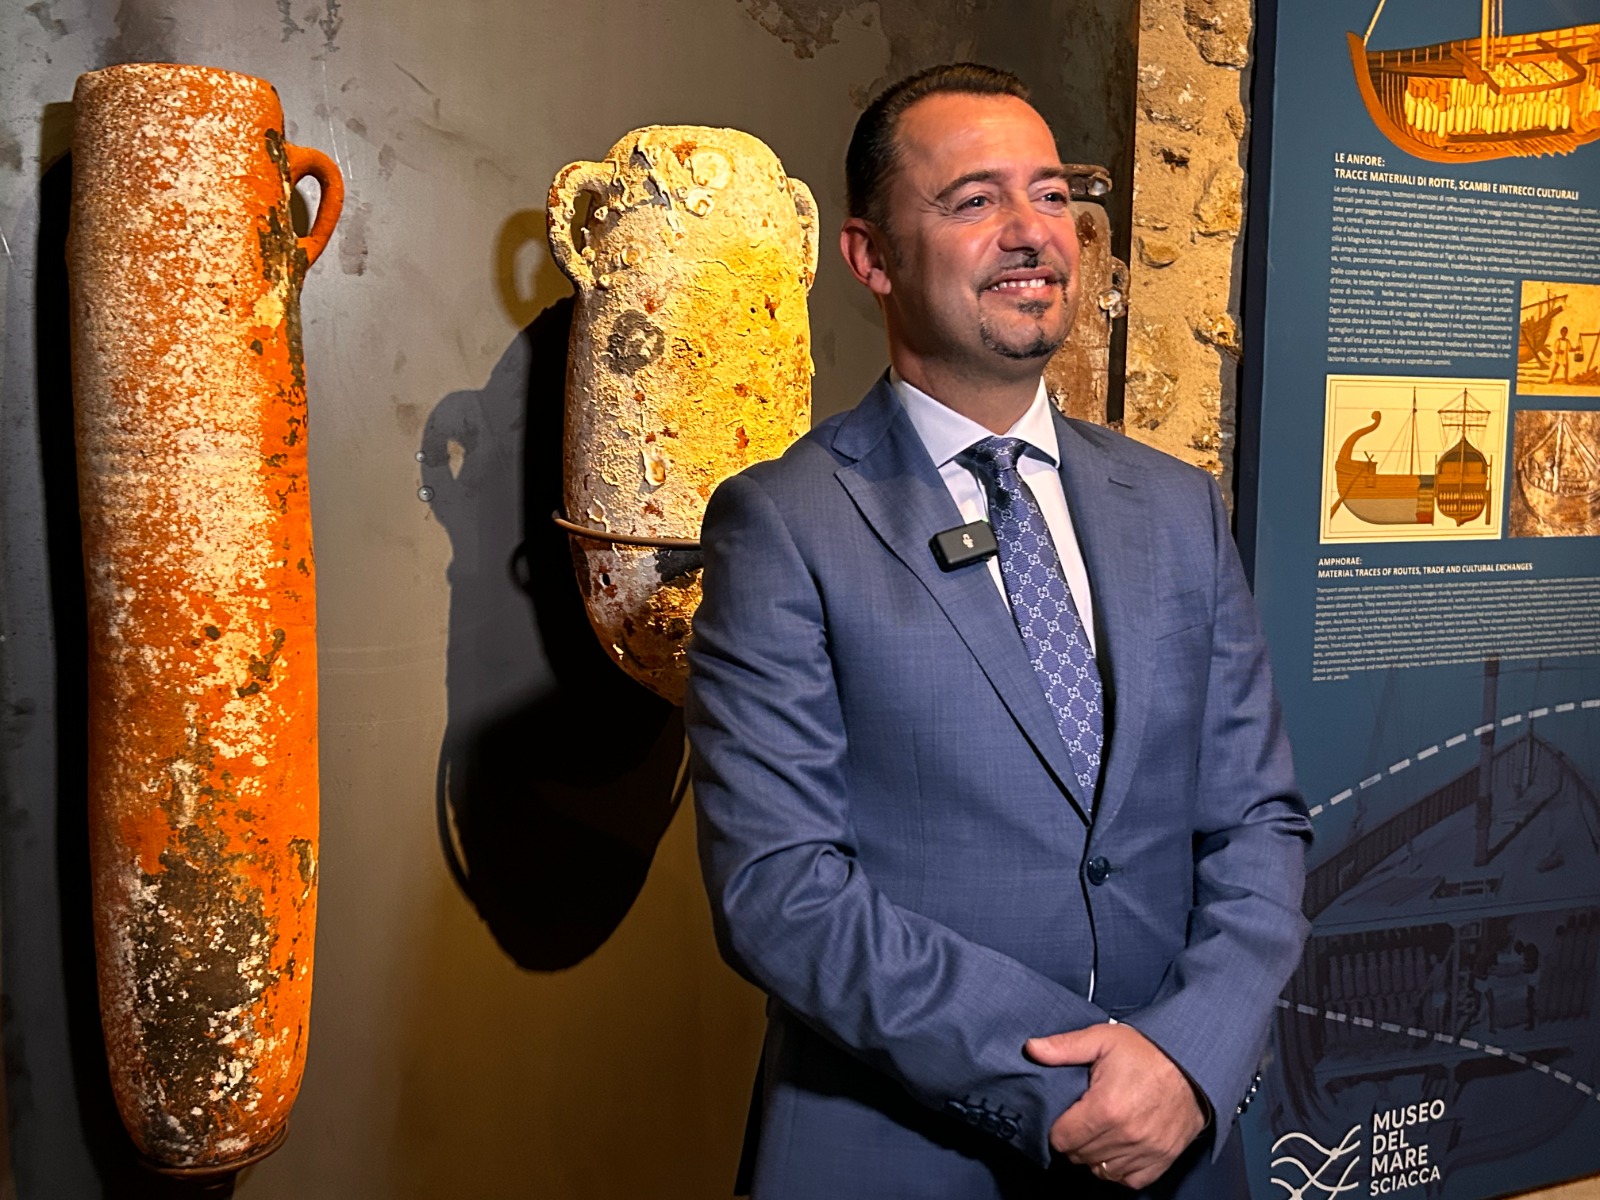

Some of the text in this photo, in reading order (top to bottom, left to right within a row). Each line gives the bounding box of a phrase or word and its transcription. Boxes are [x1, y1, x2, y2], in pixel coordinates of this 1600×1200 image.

[1335, 153, 1385, 167] LE ANFORE:
[1334, 168, 1579, 200] TRACCE MATERIALI DI ROTTE, SCAMBI E INTRECCI CULTURALI
[1318, 557, 1363, 566] AMPHORAE:
[1318, 570, 1353, 578] MATERIAL
[1355, 568, 1381, 577] TRACES
[1382, 567, 1392, 576] OF
[1393, 567, 1421, 576] ROUTES,
[1423, 566, 1445, 574] TRADE
[1462, 564, 1494, 573] CULTURAL
[1495, 563, 1533, 571] EXCHANGES
[1373, 1099, 1445, 1133] MUSEO
[1372, 1129, 1409, 1155] DEL
[1371, 1145, 1428, 1177] MARE
[1370, 1165, 1441, 1196] SCIACCA
